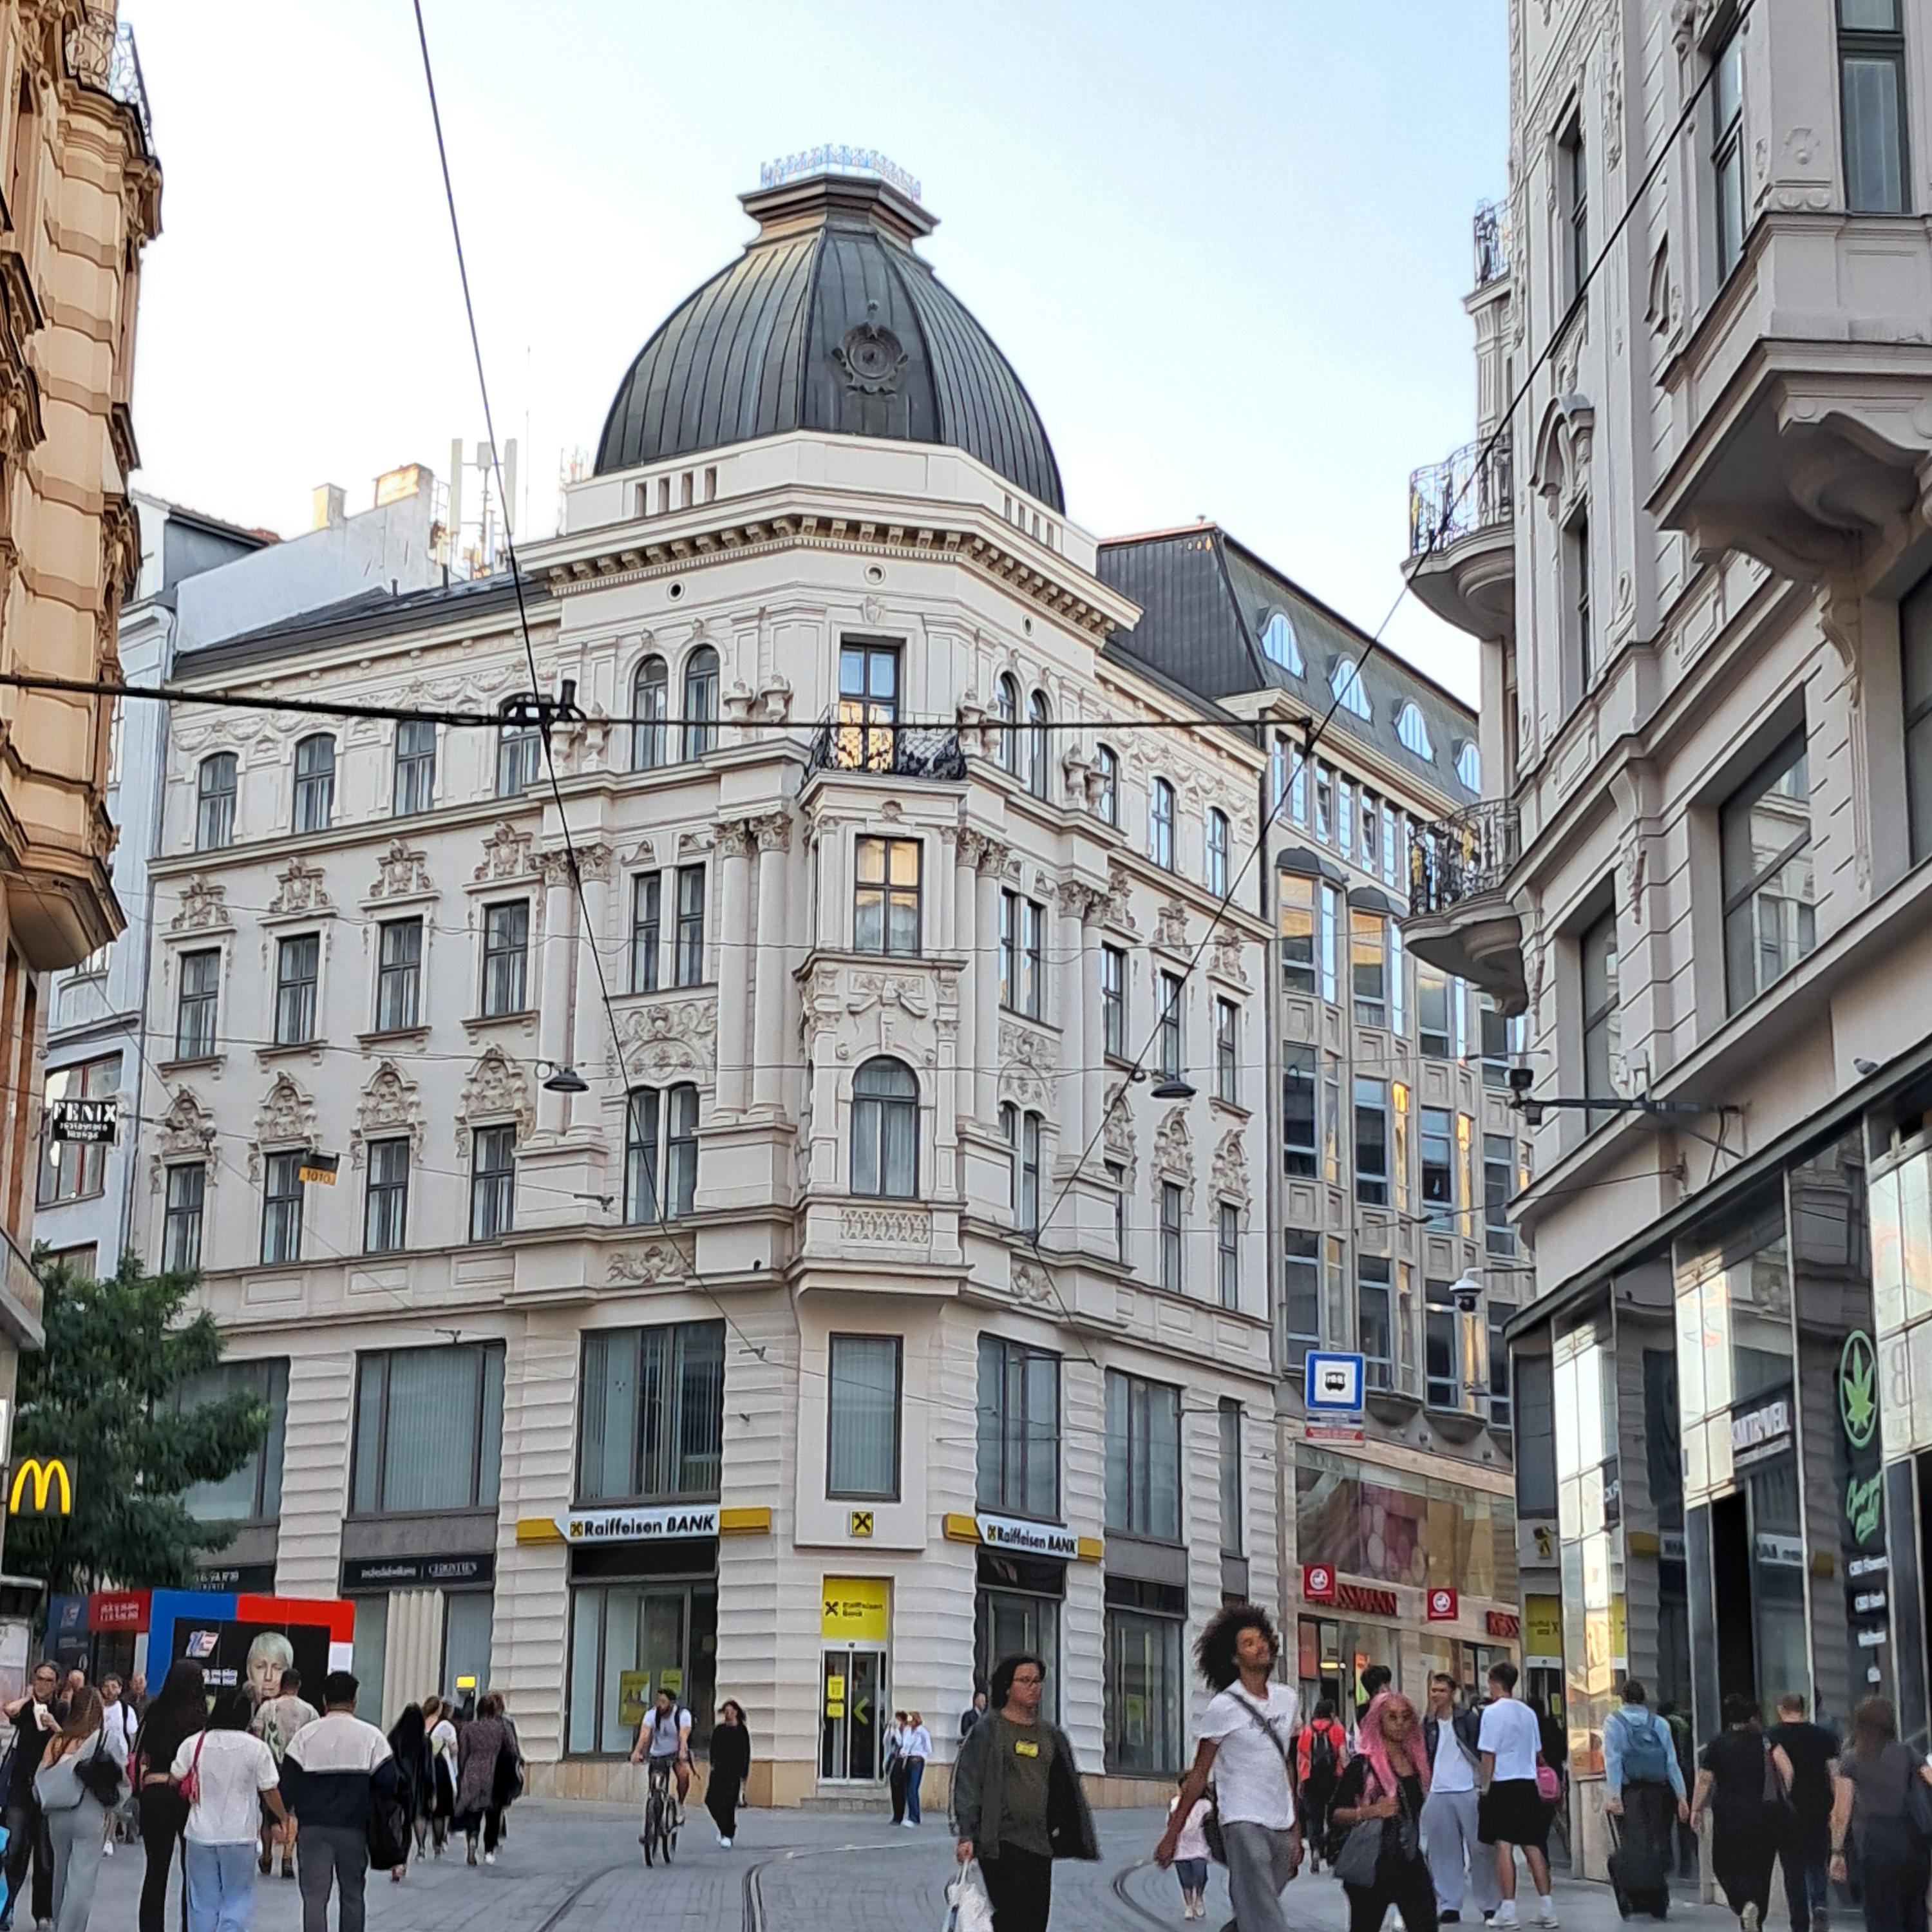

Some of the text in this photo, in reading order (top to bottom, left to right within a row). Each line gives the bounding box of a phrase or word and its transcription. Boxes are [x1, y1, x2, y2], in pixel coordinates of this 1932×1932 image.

[53, 1102, 116, 1122] FENIX
[306, 1170, 331, 1184] 1010
[667, 1513, 715, 1533] BANK
[1047, 1533, 1077, 1554] BANK
